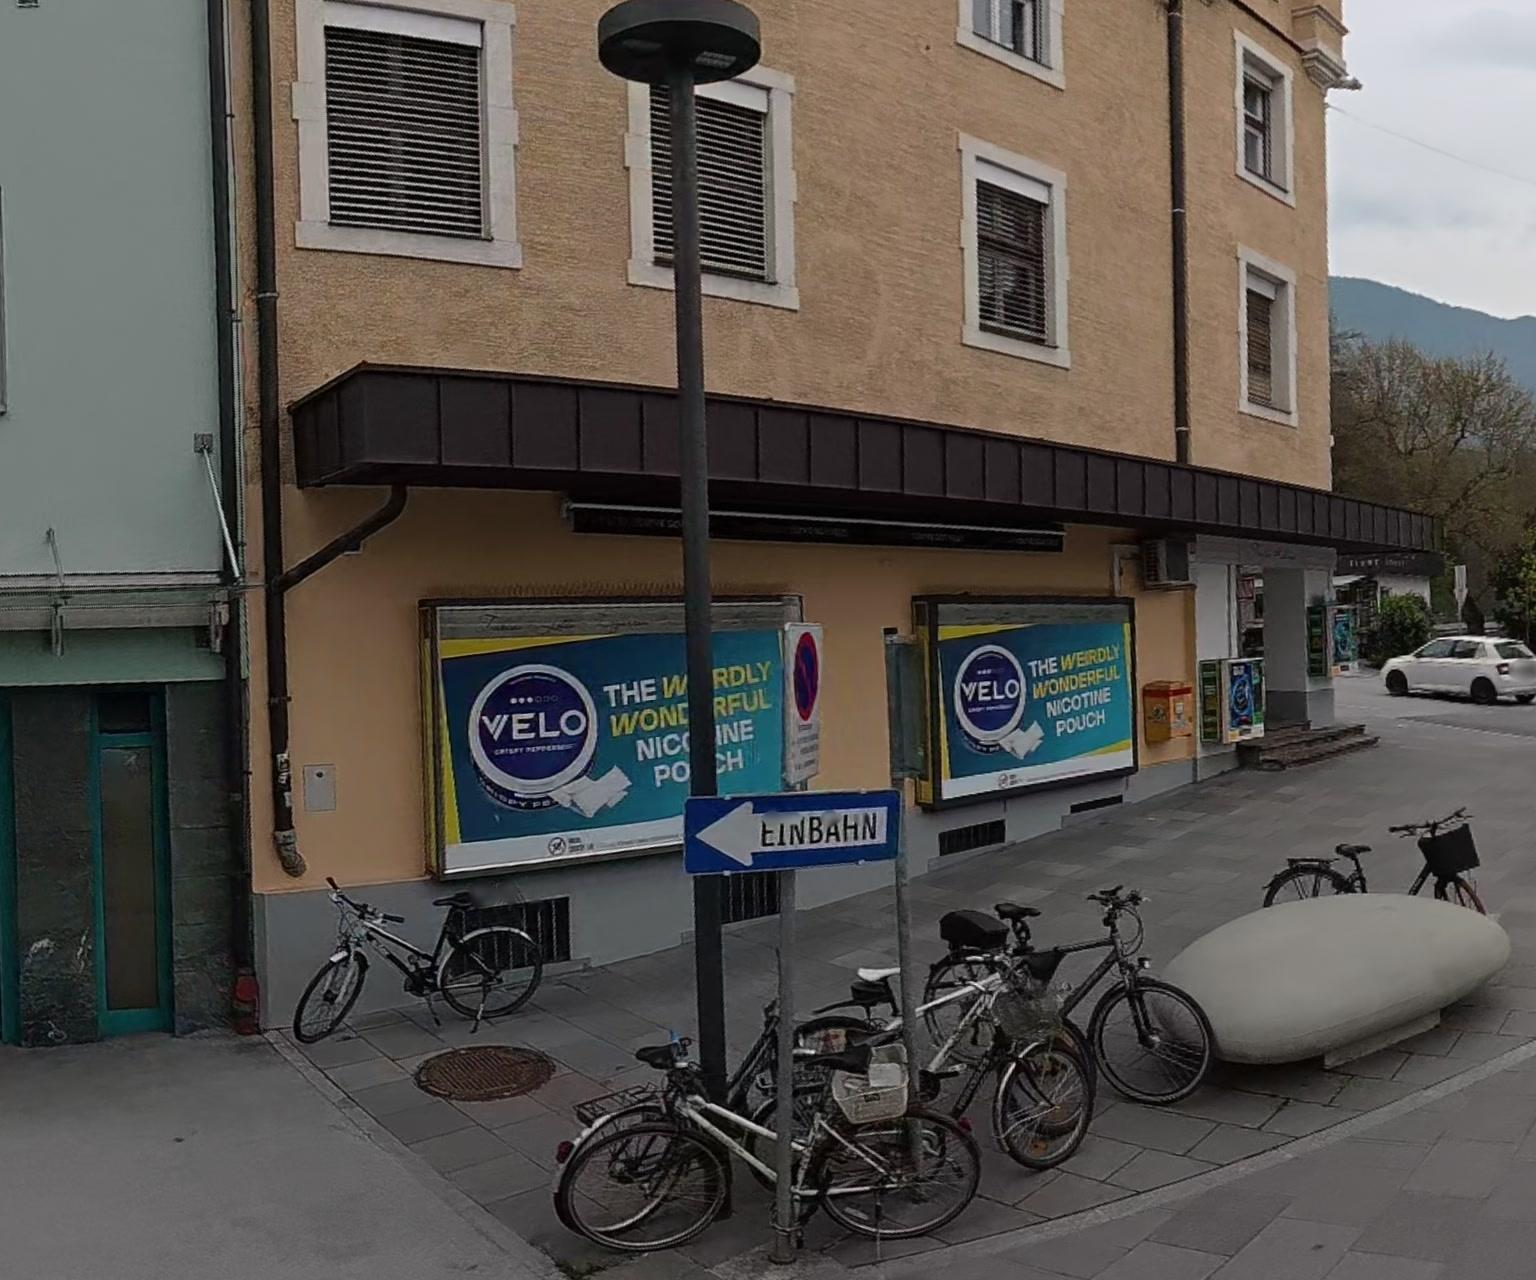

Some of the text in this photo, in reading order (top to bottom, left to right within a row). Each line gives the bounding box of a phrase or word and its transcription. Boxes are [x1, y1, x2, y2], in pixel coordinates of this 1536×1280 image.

[1028, 644, 1121, 677] THE WEIRDLY
[603, 661, 772, 707] THE WRDLY
[961, 678, 1020, 702] VELO
[1033, 665, 1121, 700] WONDERFUL
[609, 689, 772, 737] WONDRFUL
[1046, 687, 1111, 719] NICOTINE
[481, 709, 587, 741] VELO
[636, 719, 754, 761] NICINE
[1056, 709, 1106, 737] POUCH
[654, 749, 744, 787] POCH
[761, 812, 877, 847] EINBAHN
